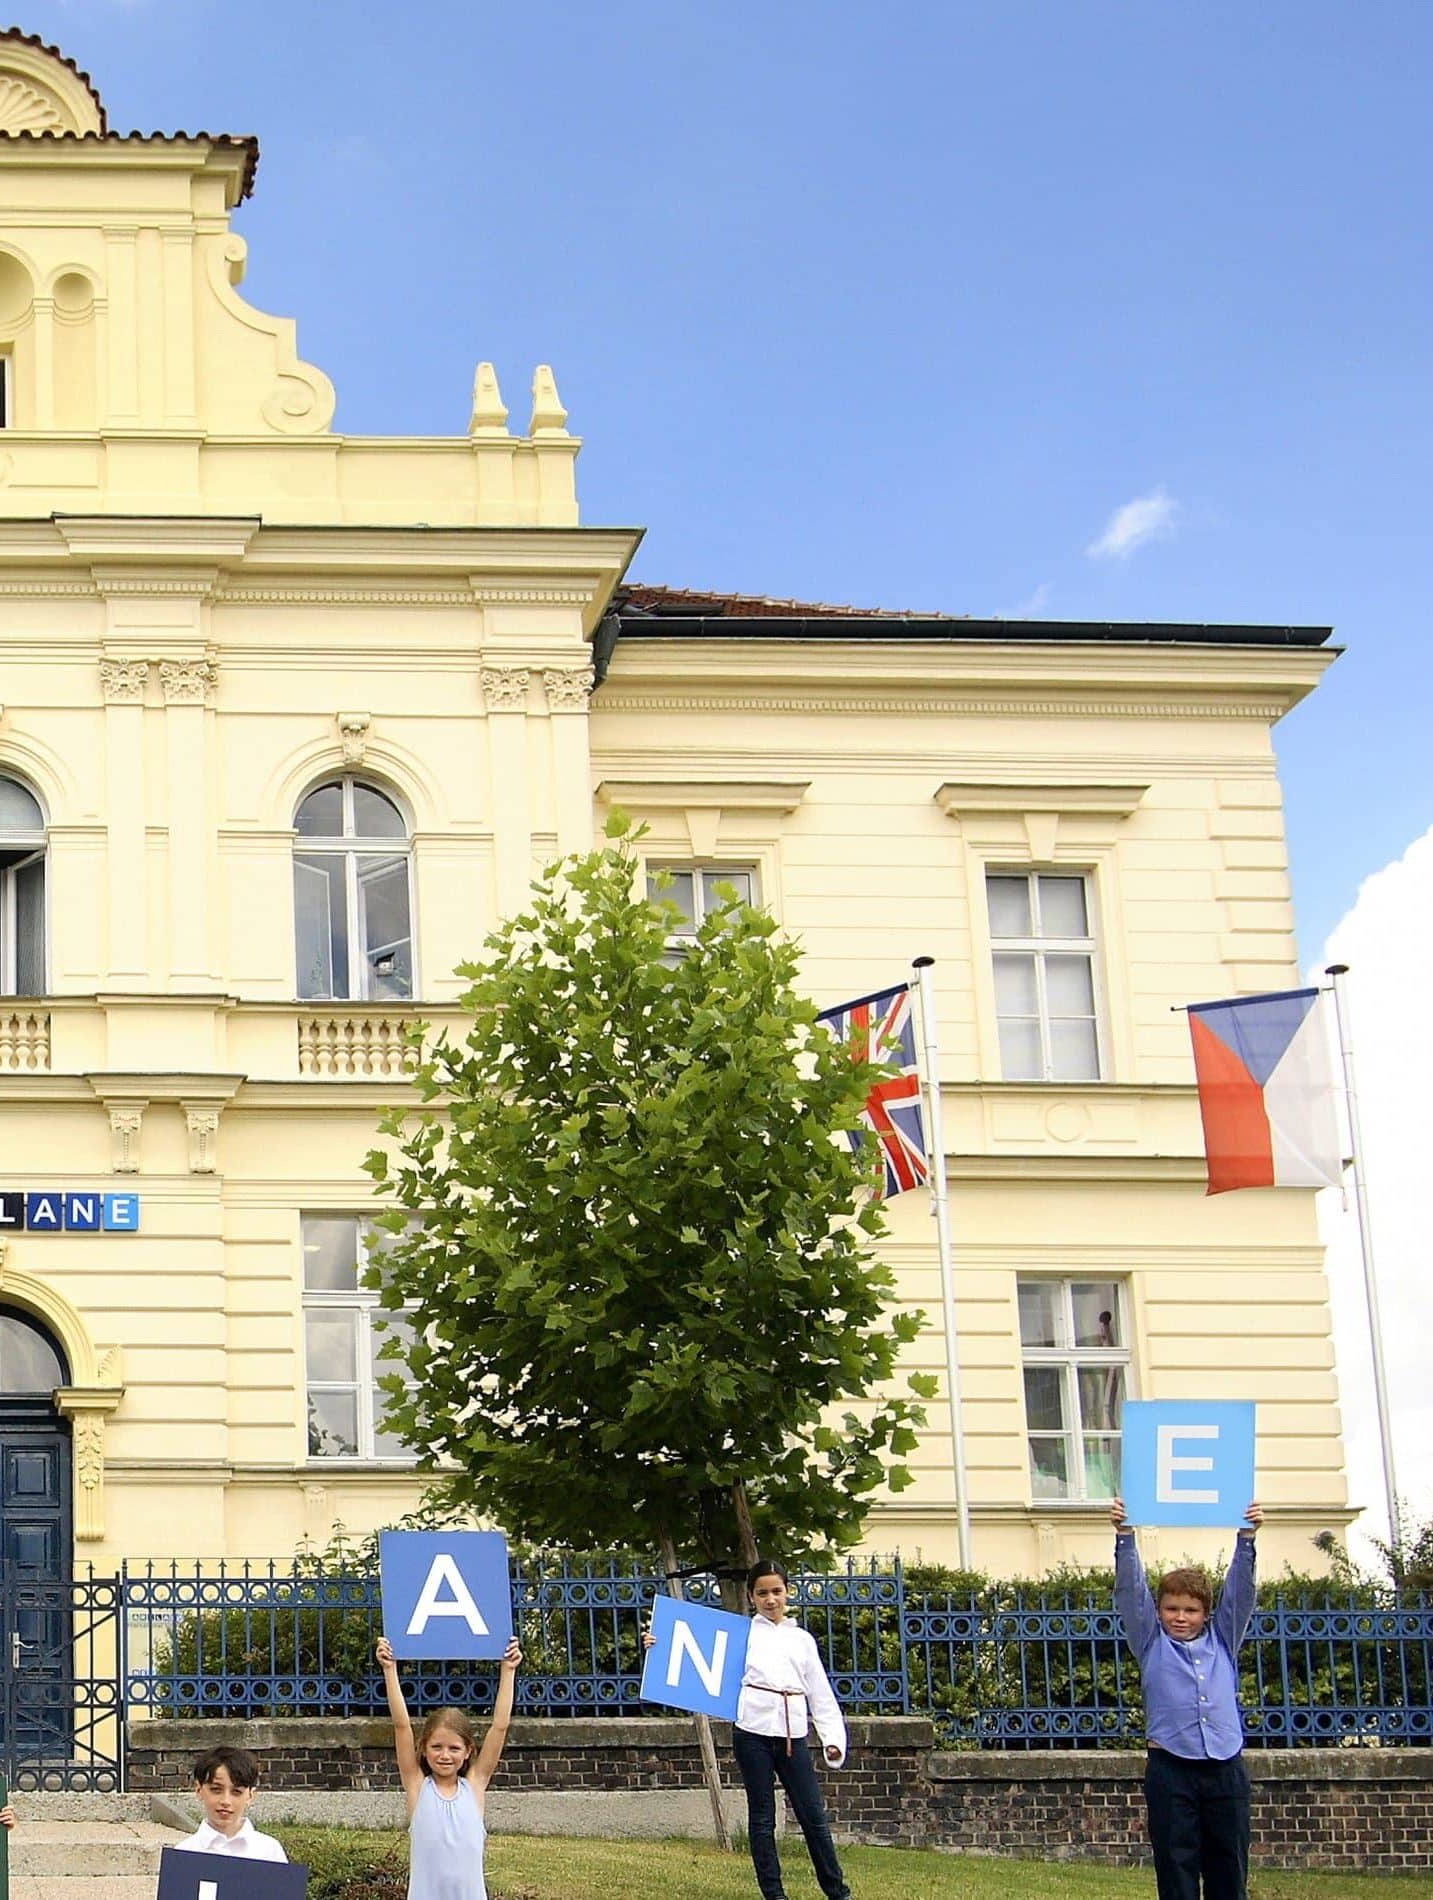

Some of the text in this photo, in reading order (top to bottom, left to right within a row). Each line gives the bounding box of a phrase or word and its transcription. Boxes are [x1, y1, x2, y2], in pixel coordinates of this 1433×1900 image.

[1156, 1424, 1219, 1504] E
[406, 1553, 489, 1636] A
[665, 1620, 729, 1697] N
